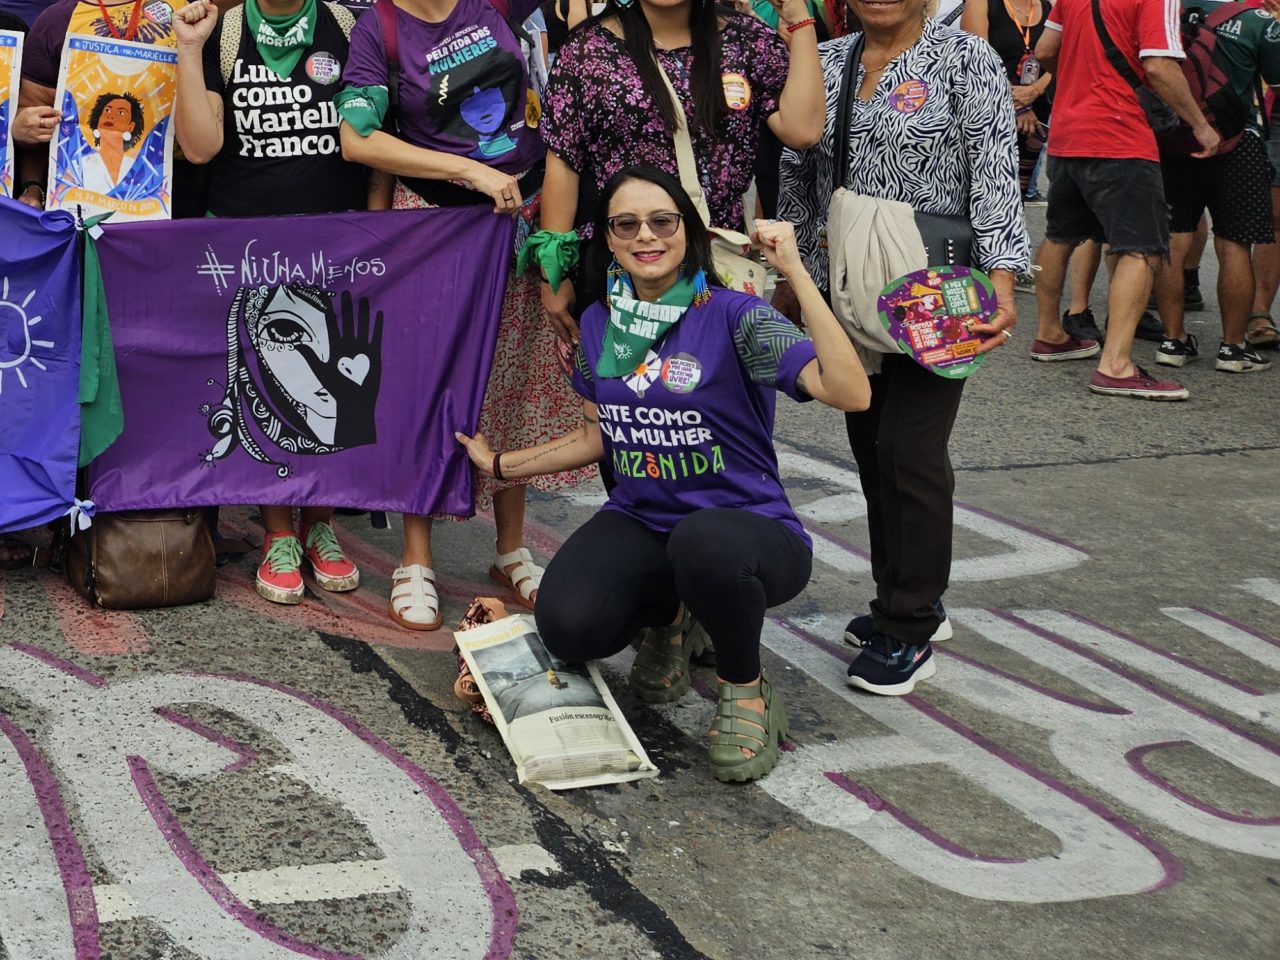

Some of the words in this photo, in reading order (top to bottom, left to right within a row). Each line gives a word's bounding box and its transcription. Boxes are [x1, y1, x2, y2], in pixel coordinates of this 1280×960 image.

[82, 40, 120, 54] JUSTIÇA
[134, 49, 173, 63] MARIELLE
[257, 33, 298, 48] MORTA
[425, 47, 450, 63] PELA
[448, 35, 473, 53] VIDA
[470, 26, 491, 42] DAS
[427, 36, 498, 75] MULHERES
[232, 84, 313, 108] como
[233, 101, 341, 134] Mariell
[238, 133, 341, 158] Franco.
[634, 406, 703, 427] COMO
[629, 426, 714, 448] MULHER
[548, 710, 576, 725] Fusión
